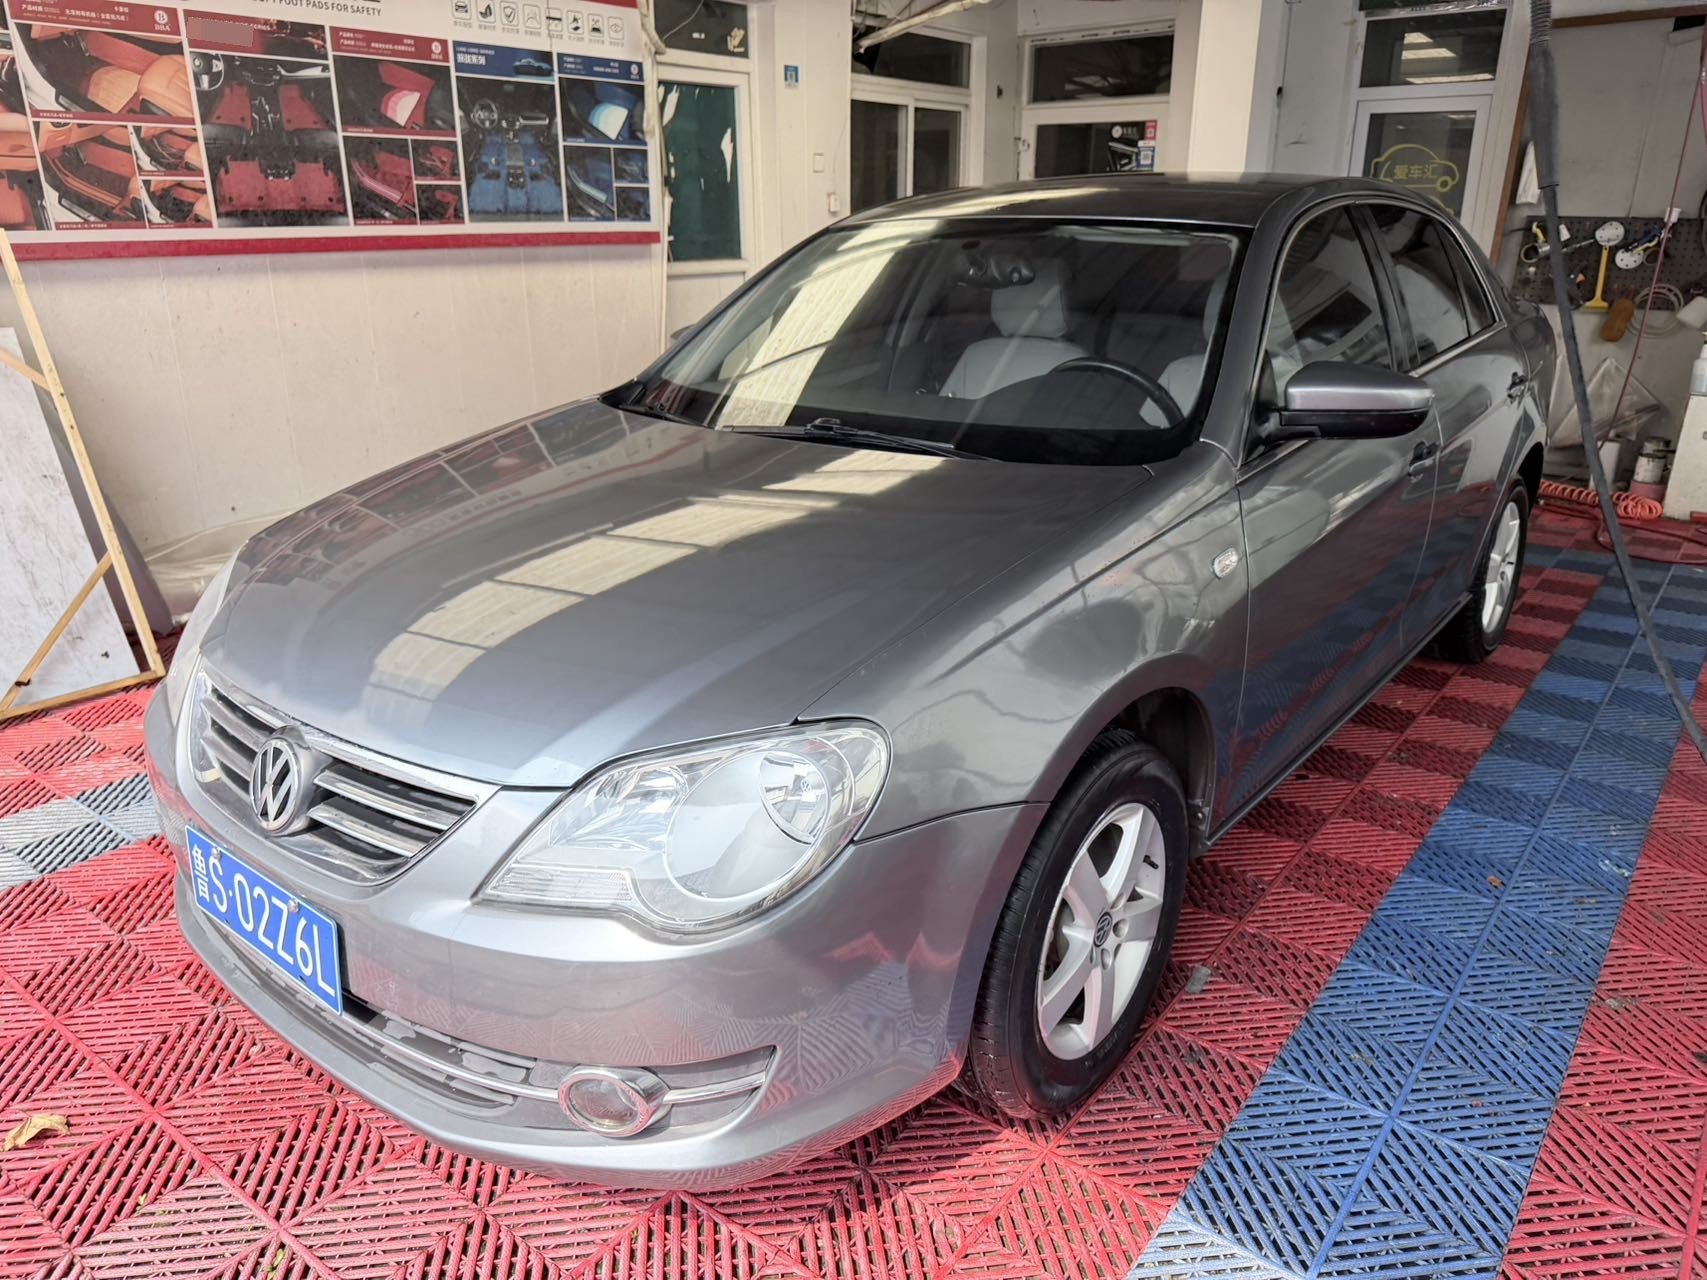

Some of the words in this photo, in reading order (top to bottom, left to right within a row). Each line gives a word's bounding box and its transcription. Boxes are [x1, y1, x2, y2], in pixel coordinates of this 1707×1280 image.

[306, 0, 330, 10] PADS
[331, 2, 349, 13] FOR
[350, 5, 381, 16] SAFETY
